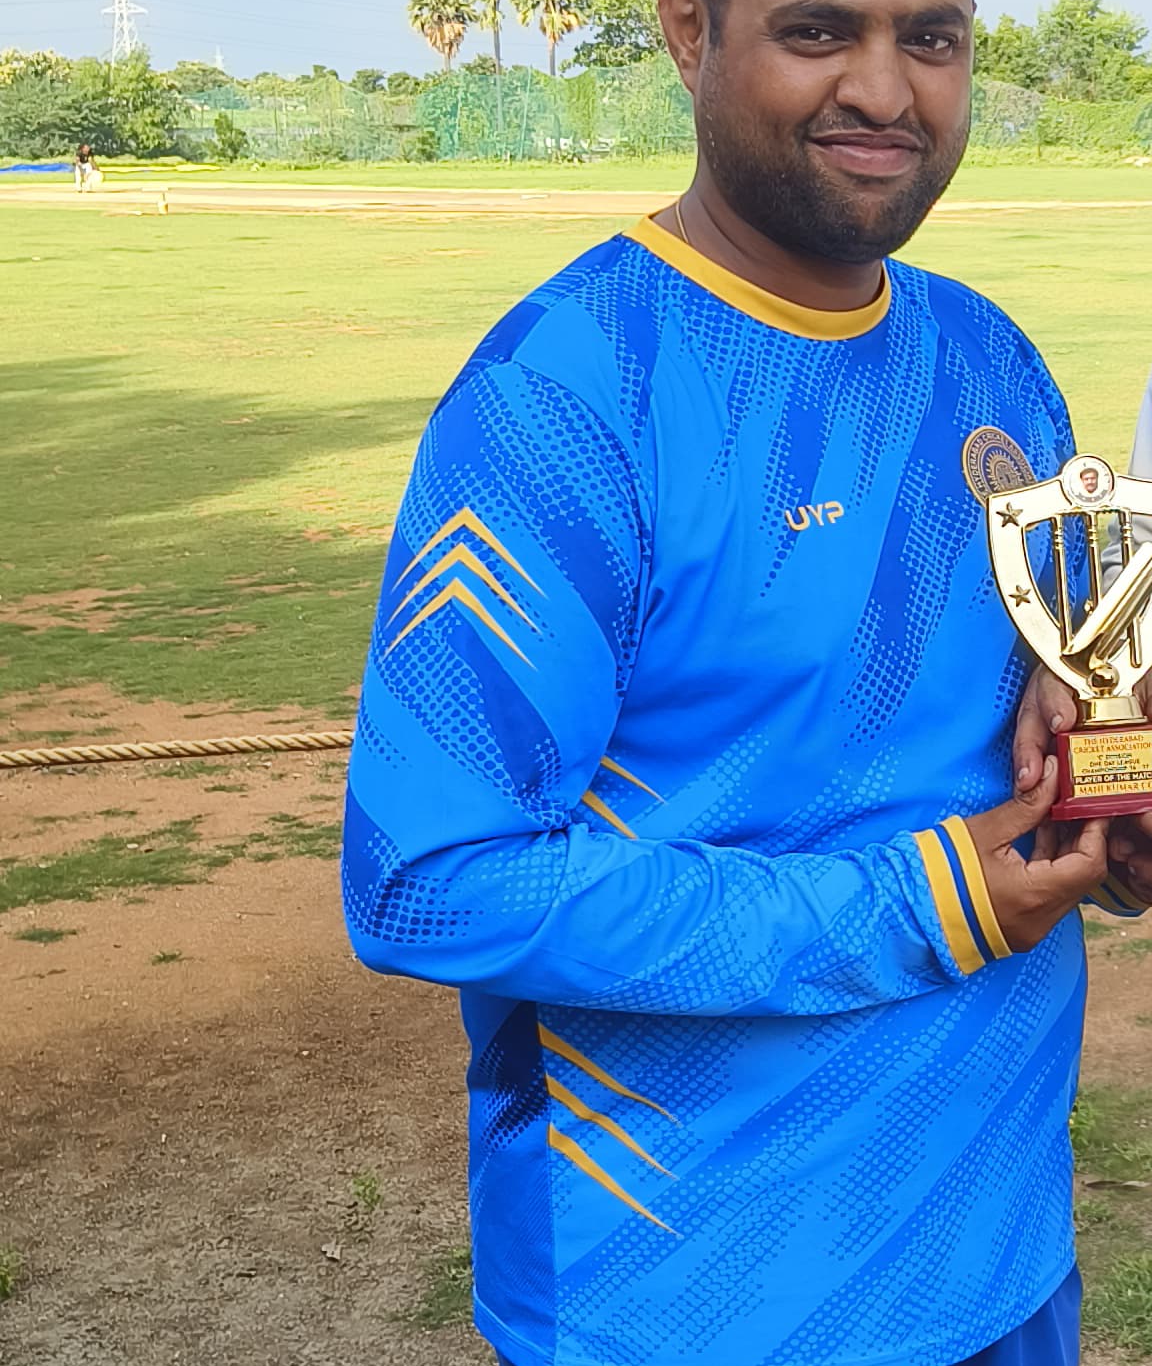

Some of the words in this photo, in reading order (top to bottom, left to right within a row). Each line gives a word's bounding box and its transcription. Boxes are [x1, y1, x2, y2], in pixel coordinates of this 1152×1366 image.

[784, 500, 845, 531] UYP
[1075, 776, 1103, 784] PLAYER
[1117, 773, 1131, 781] THE
